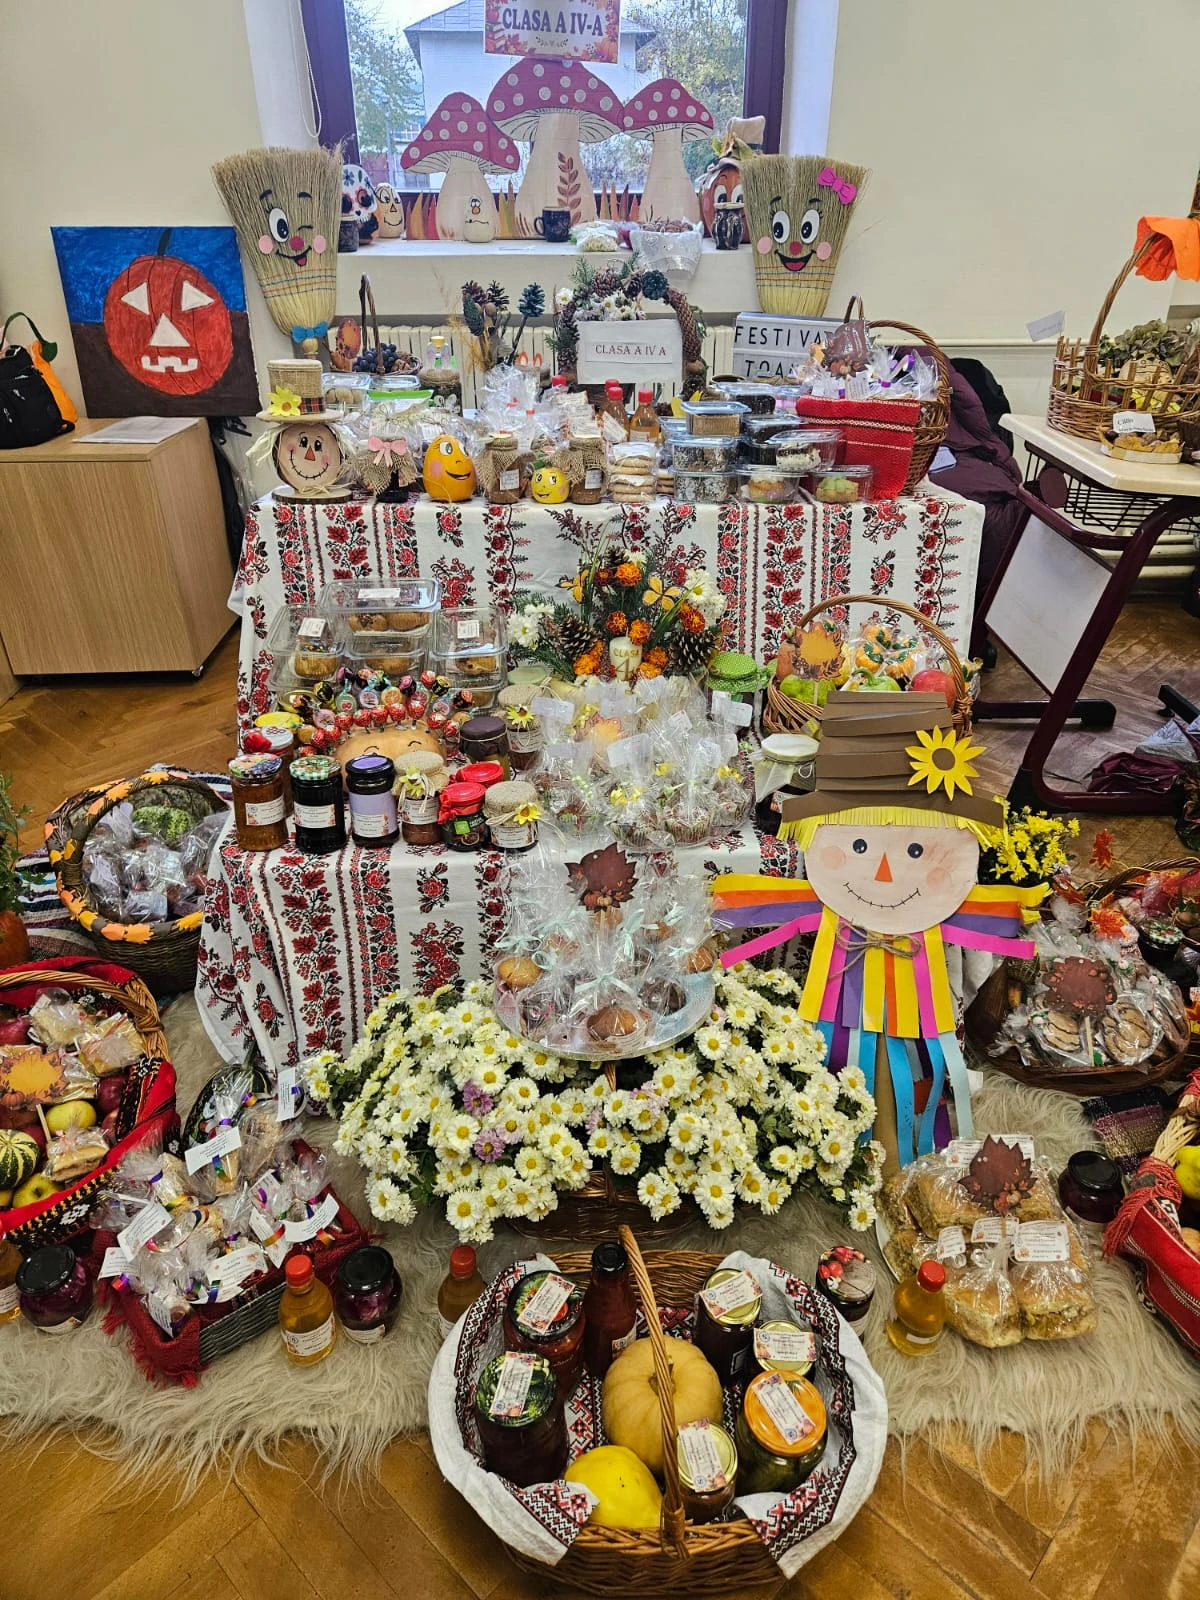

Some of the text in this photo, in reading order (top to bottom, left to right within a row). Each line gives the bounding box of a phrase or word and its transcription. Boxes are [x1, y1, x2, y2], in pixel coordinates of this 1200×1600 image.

[502, 8, 604, 37] CLASA A IV-A
[734, 325, 824, 348] FESTIVA
[595, 344, 667, 356] CLASA A IV A
[745, 360, 799, 379] TOA
